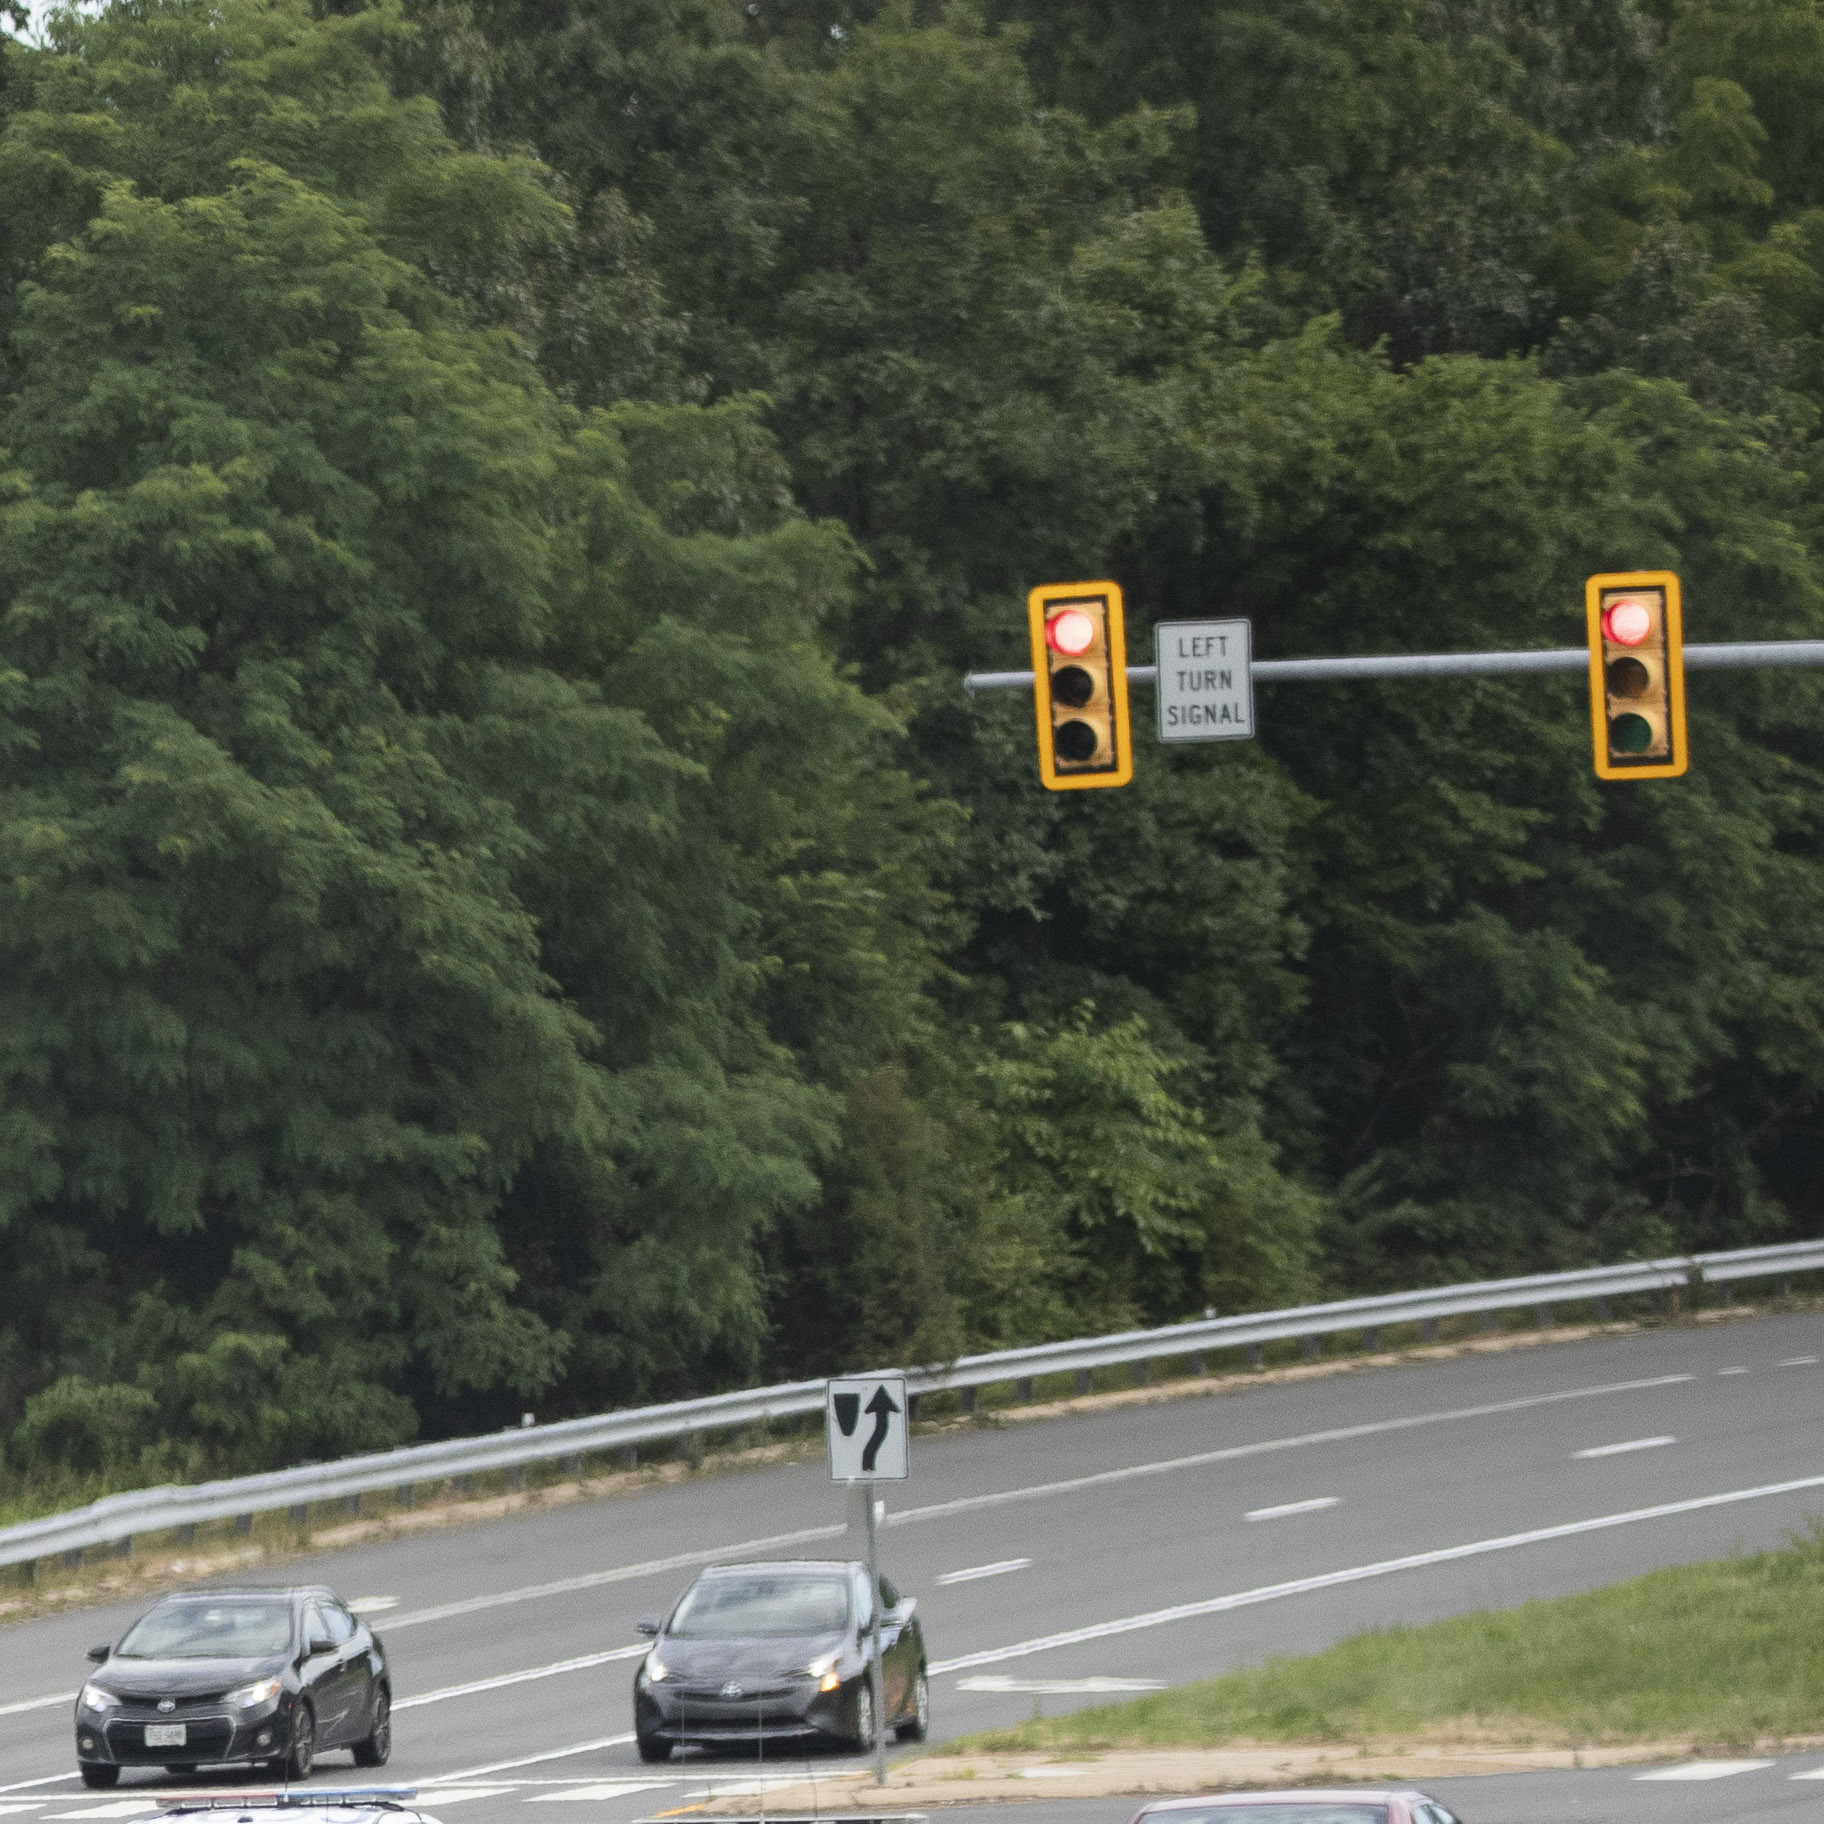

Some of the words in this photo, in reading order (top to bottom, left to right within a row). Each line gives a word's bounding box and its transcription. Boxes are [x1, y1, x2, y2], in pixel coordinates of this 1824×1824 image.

[1178, 635, 1228, 657] LEFT
[1176, 670, 1232, 692] TURN
[1167, 703, 1245, 726] SIGNAL
